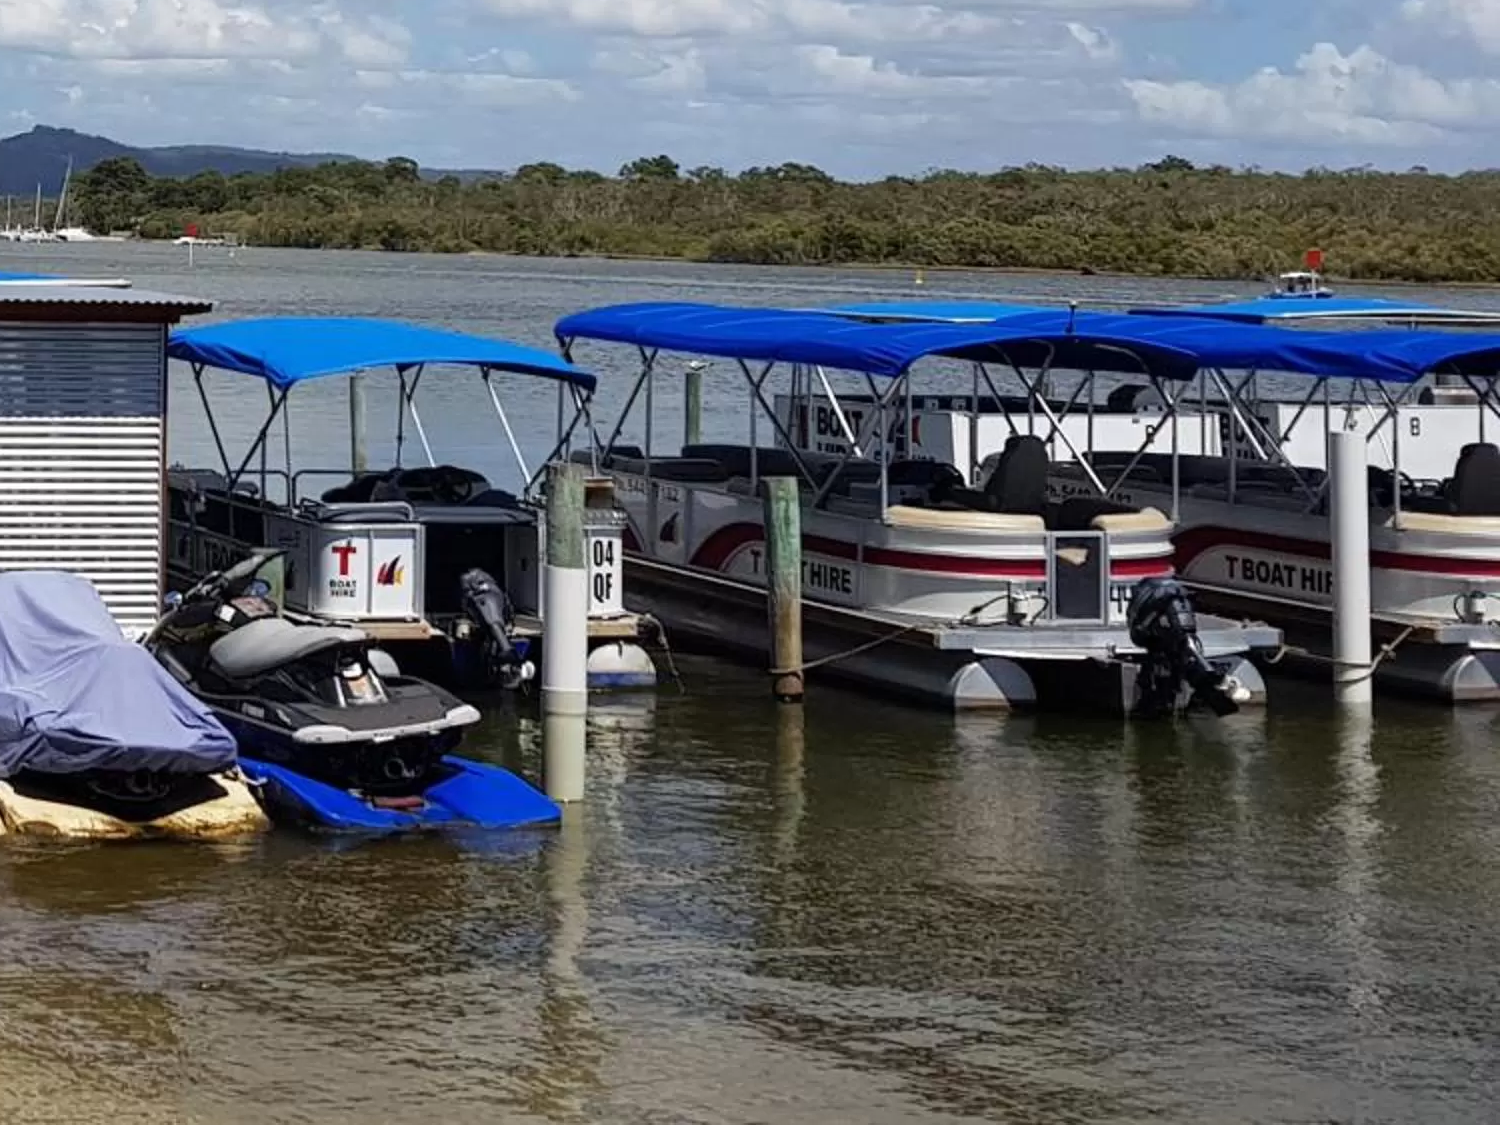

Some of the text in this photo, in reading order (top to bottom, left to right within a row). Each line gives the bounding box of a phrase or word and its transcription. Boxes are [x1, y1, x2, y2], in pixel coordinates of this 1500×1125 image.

[331, 546, 357, 576] T
[593, 540, 613, 567] 04
[329, 579, 357, 588] BOAT
[809, 560, 853, 594] HIRE
[1225, 555, 1239, 579] T
[1242, 558, 1296, 588] BOAT
[330, 589, 356, 598] HIRE
[593, 573, 613, 603] QF
